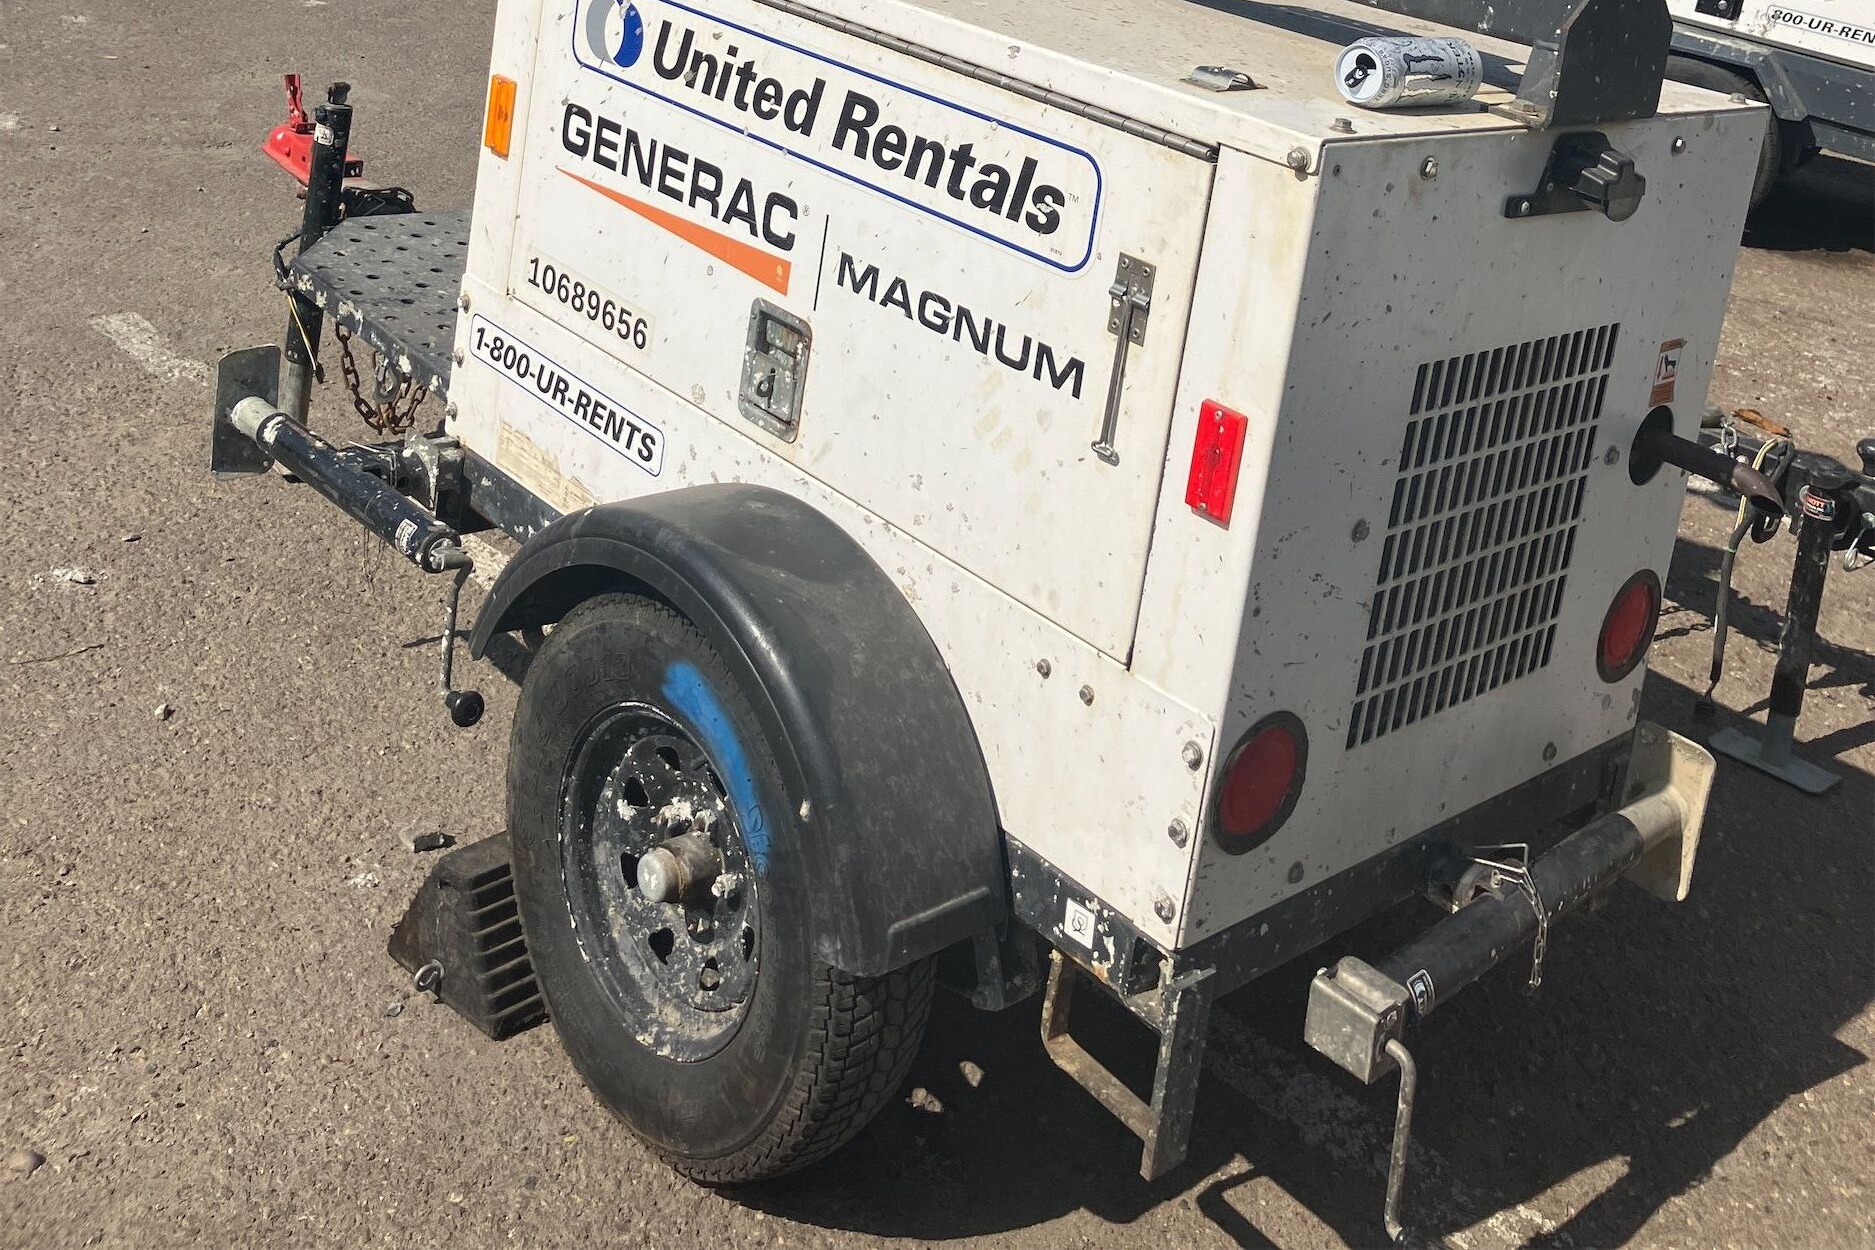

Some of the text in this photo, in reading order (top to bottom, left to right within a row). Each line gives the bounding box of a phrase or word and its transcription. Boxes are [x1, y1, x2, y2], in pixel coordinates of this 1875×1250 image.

[562, 102, 798, 251] GENERAC
[653, 20, 826, 138] United
[832, 90, 1066, 235] Rentals
[527, 256, 649, 350] 10689656
[837, 252, 1085, 400] MAGNUM
[475, 326, 657, 463] 1-800-UR-RENTS
